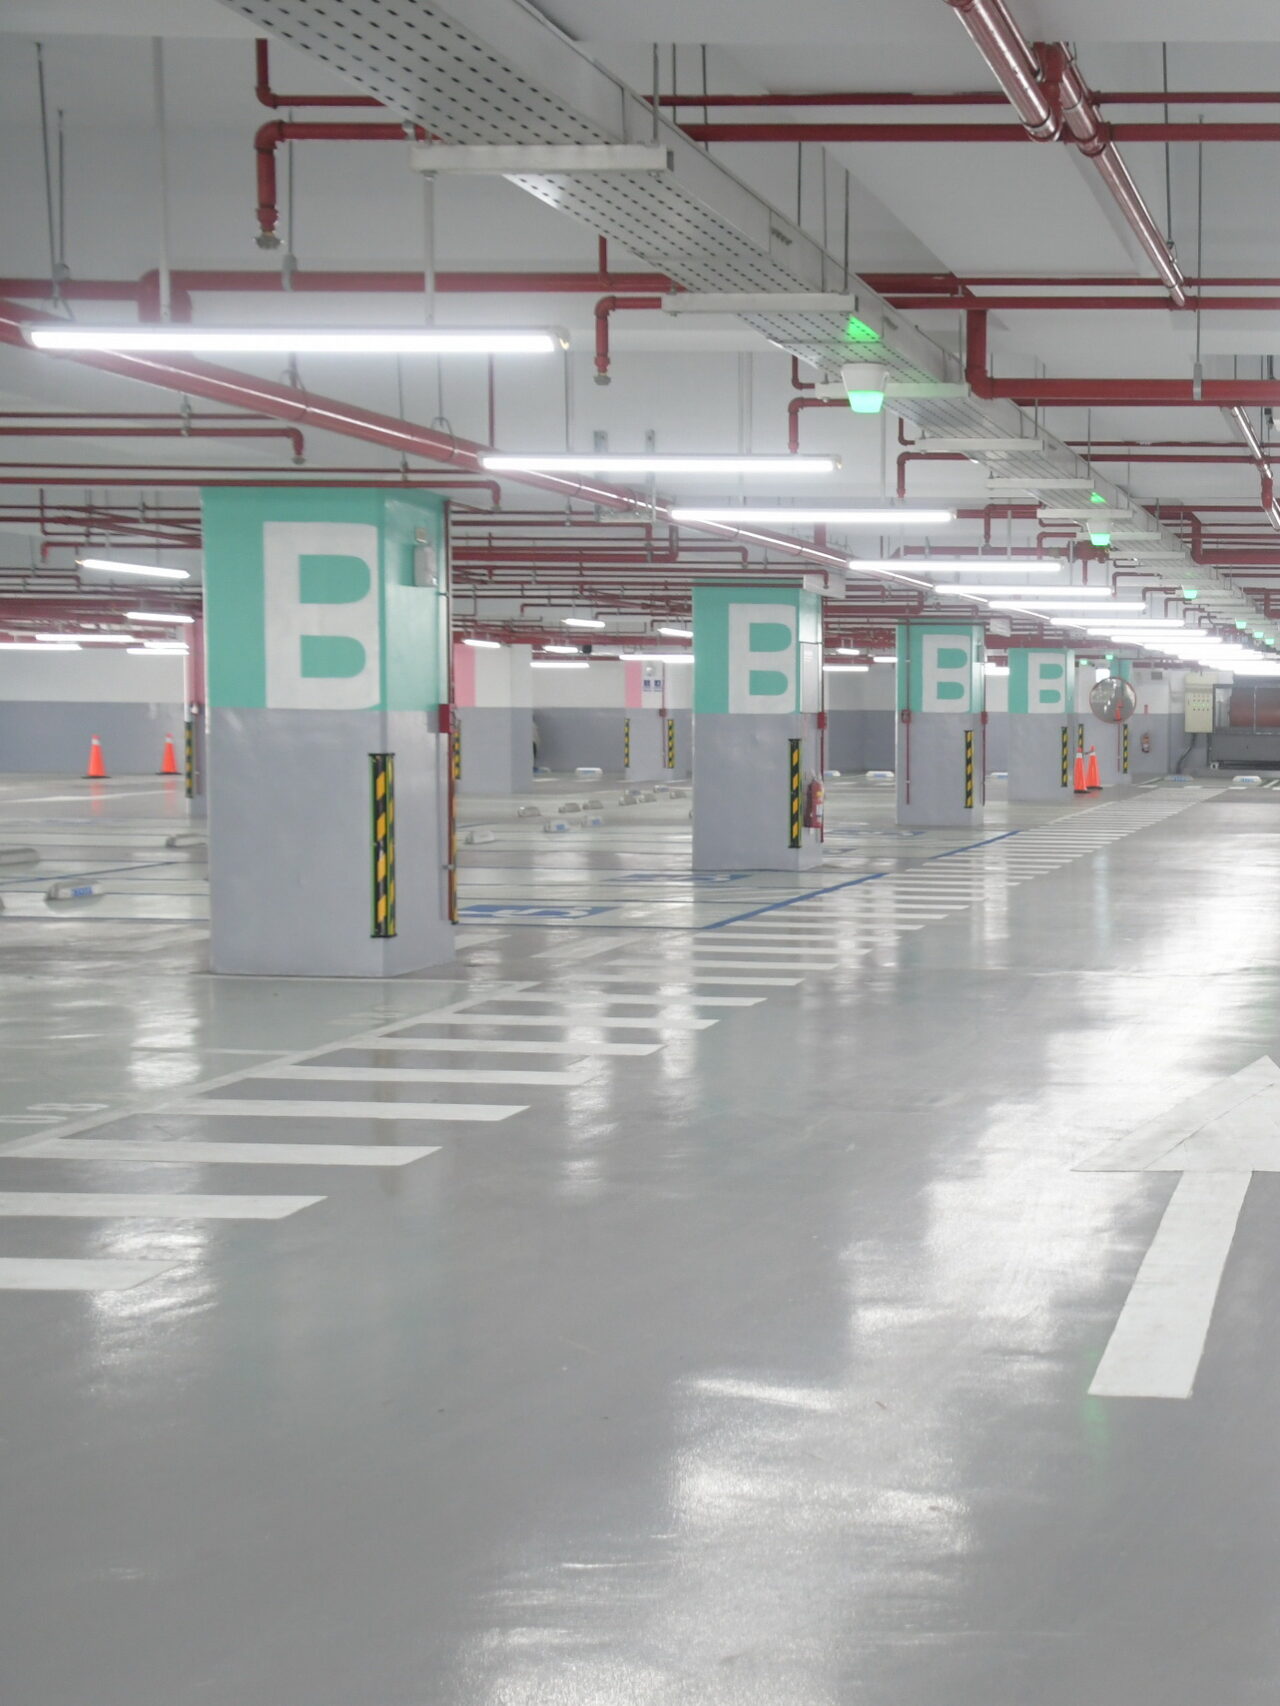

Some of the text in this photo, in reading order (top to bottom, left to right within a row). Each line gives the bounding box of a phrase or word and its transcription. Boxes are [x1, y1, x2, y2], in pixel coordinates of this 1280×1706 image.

[263, 521, 381, 710] B
[728, 603, 796, 714] B
[922, 634, 971, 713] B
[1028, 652, 1066, 714] B
